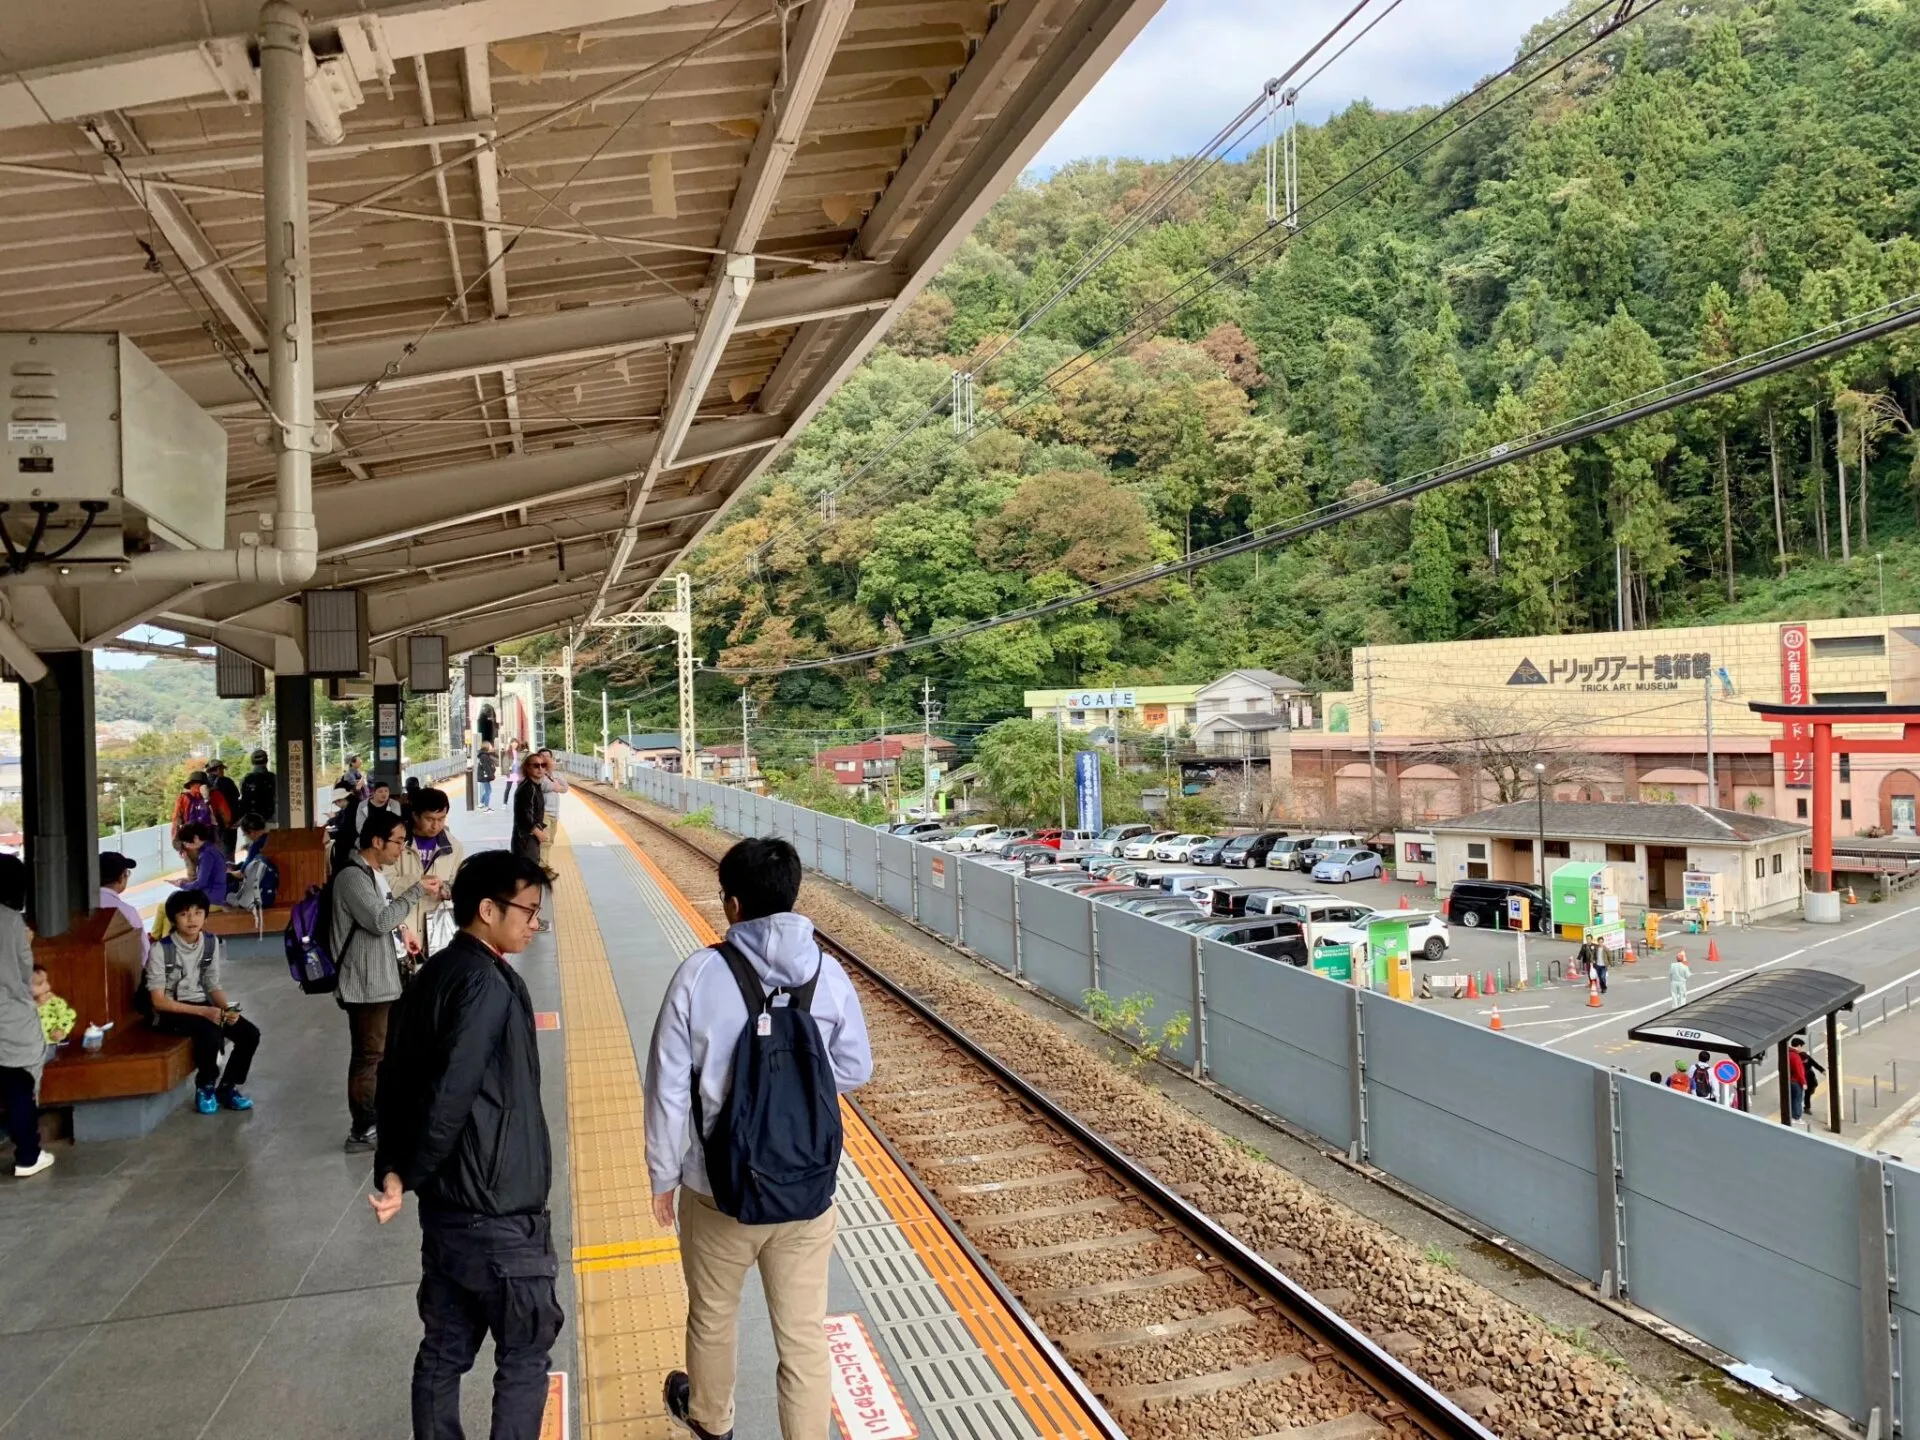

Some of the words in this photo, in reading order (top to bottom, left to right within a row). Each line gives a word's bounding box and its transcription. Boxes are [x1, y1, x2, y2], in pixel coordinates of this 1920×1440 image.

[1549, 652, 1712, 684] トリックアート美術館
[1580, 684, 1609, 693] TRICK
[1612, 682, 1632, 692] ART
[1635, 681, 1678, 691] MUSEUM
[1081, 693, 1133, 706] CAFE
[1676, 1029, 1701, 1039] KEIO
[822, 1322, 890, 1434] あしもとにごちゅうい
